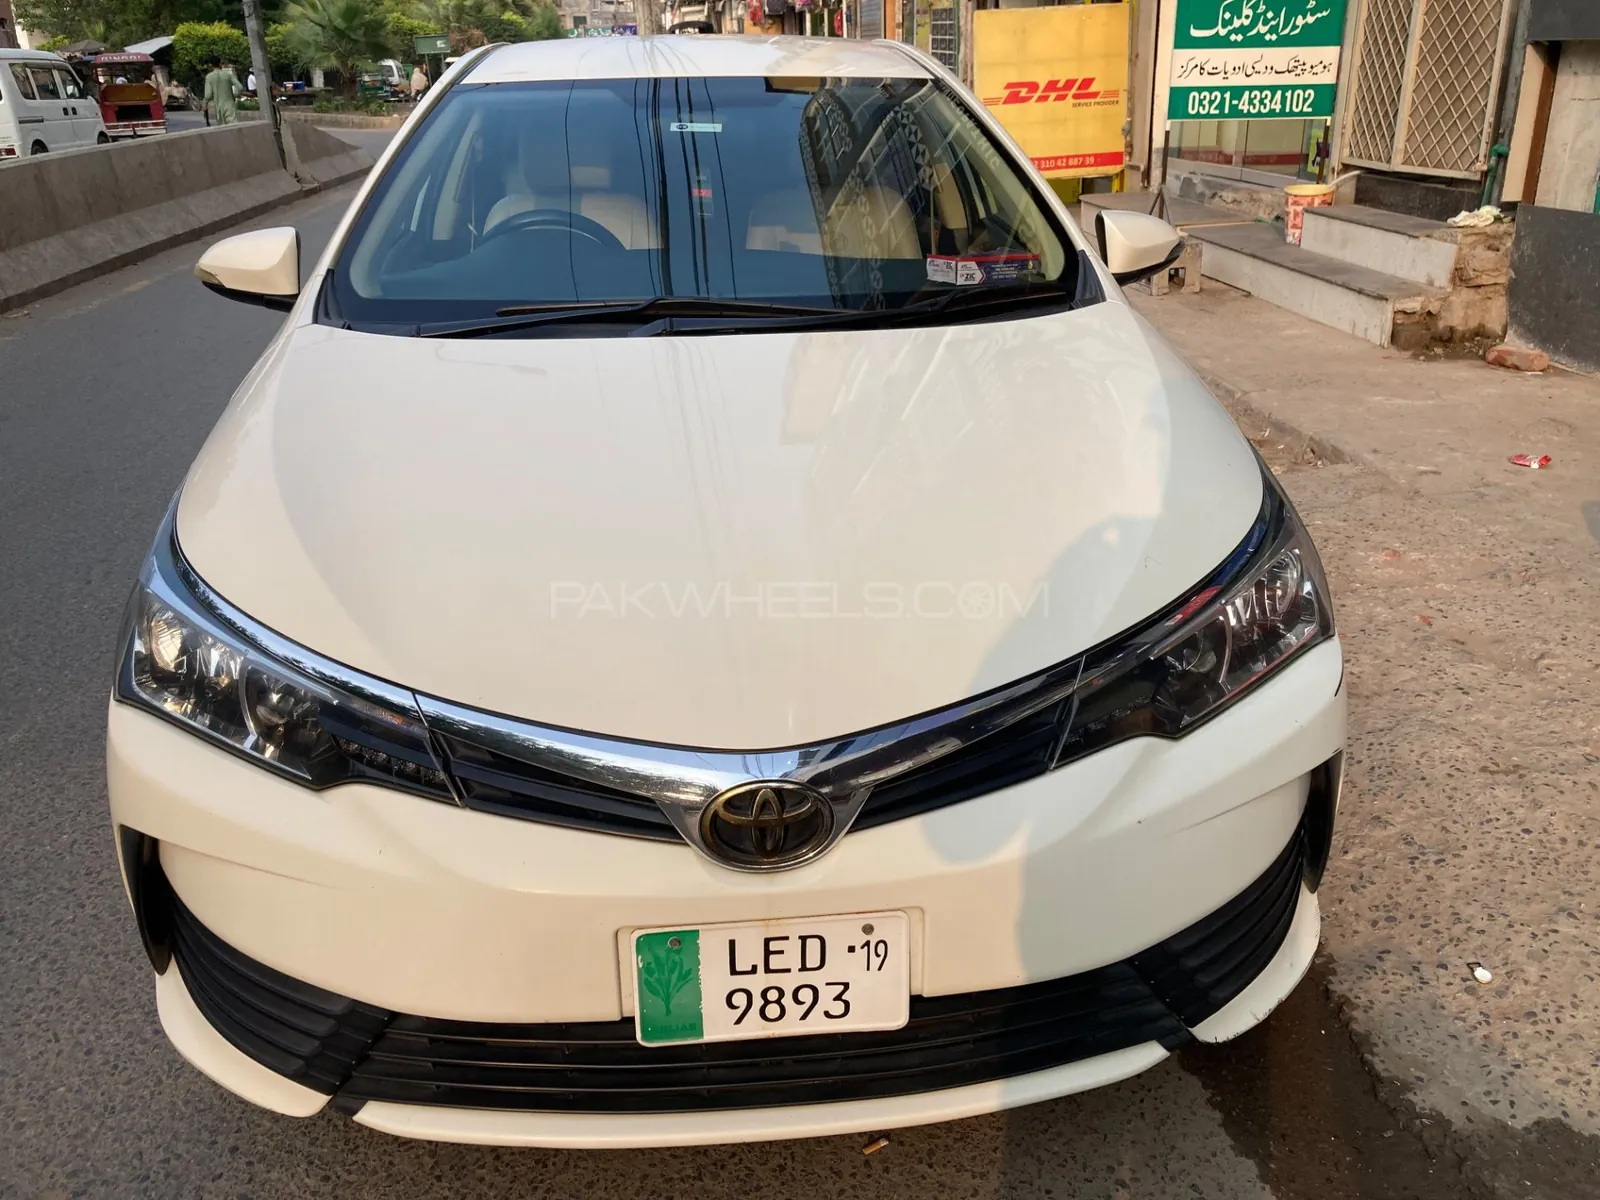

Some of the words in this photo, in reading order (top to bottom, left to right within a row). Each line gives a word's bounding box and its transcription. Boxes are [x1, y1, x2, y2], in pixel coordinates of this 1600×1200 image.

[1002, 77, 1101, 105] DHL
[1093, 99, 1119, 107] PROVIDER
[1187, 89, 1315, 115] 0321-4334102
[1040, 159, 1055, 168] 310
[1057, 157, 1067, 167] 42
[1068, 156, 1083, 166] 887
[1085, 155, 1095, 165] 39
[728, 934, 827, 976] LED
[725, 981, 851, 1026] 9893
